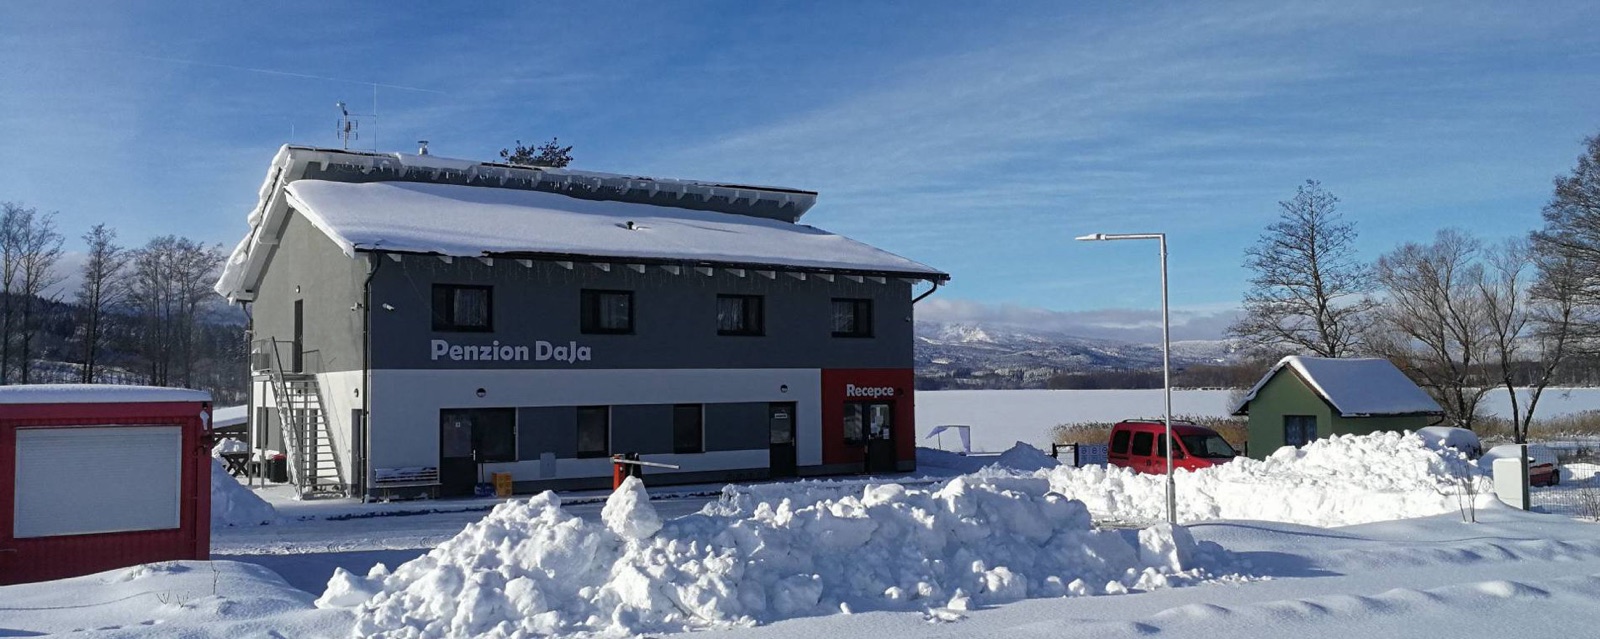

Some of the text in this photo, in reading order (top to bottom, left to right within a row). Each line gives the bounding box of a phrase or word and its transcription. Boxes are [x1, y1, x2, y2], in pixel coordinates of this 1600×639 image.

[431, 339, 592, 364] Penzion DaJa
[846, 384, 894, 398] Recepce
